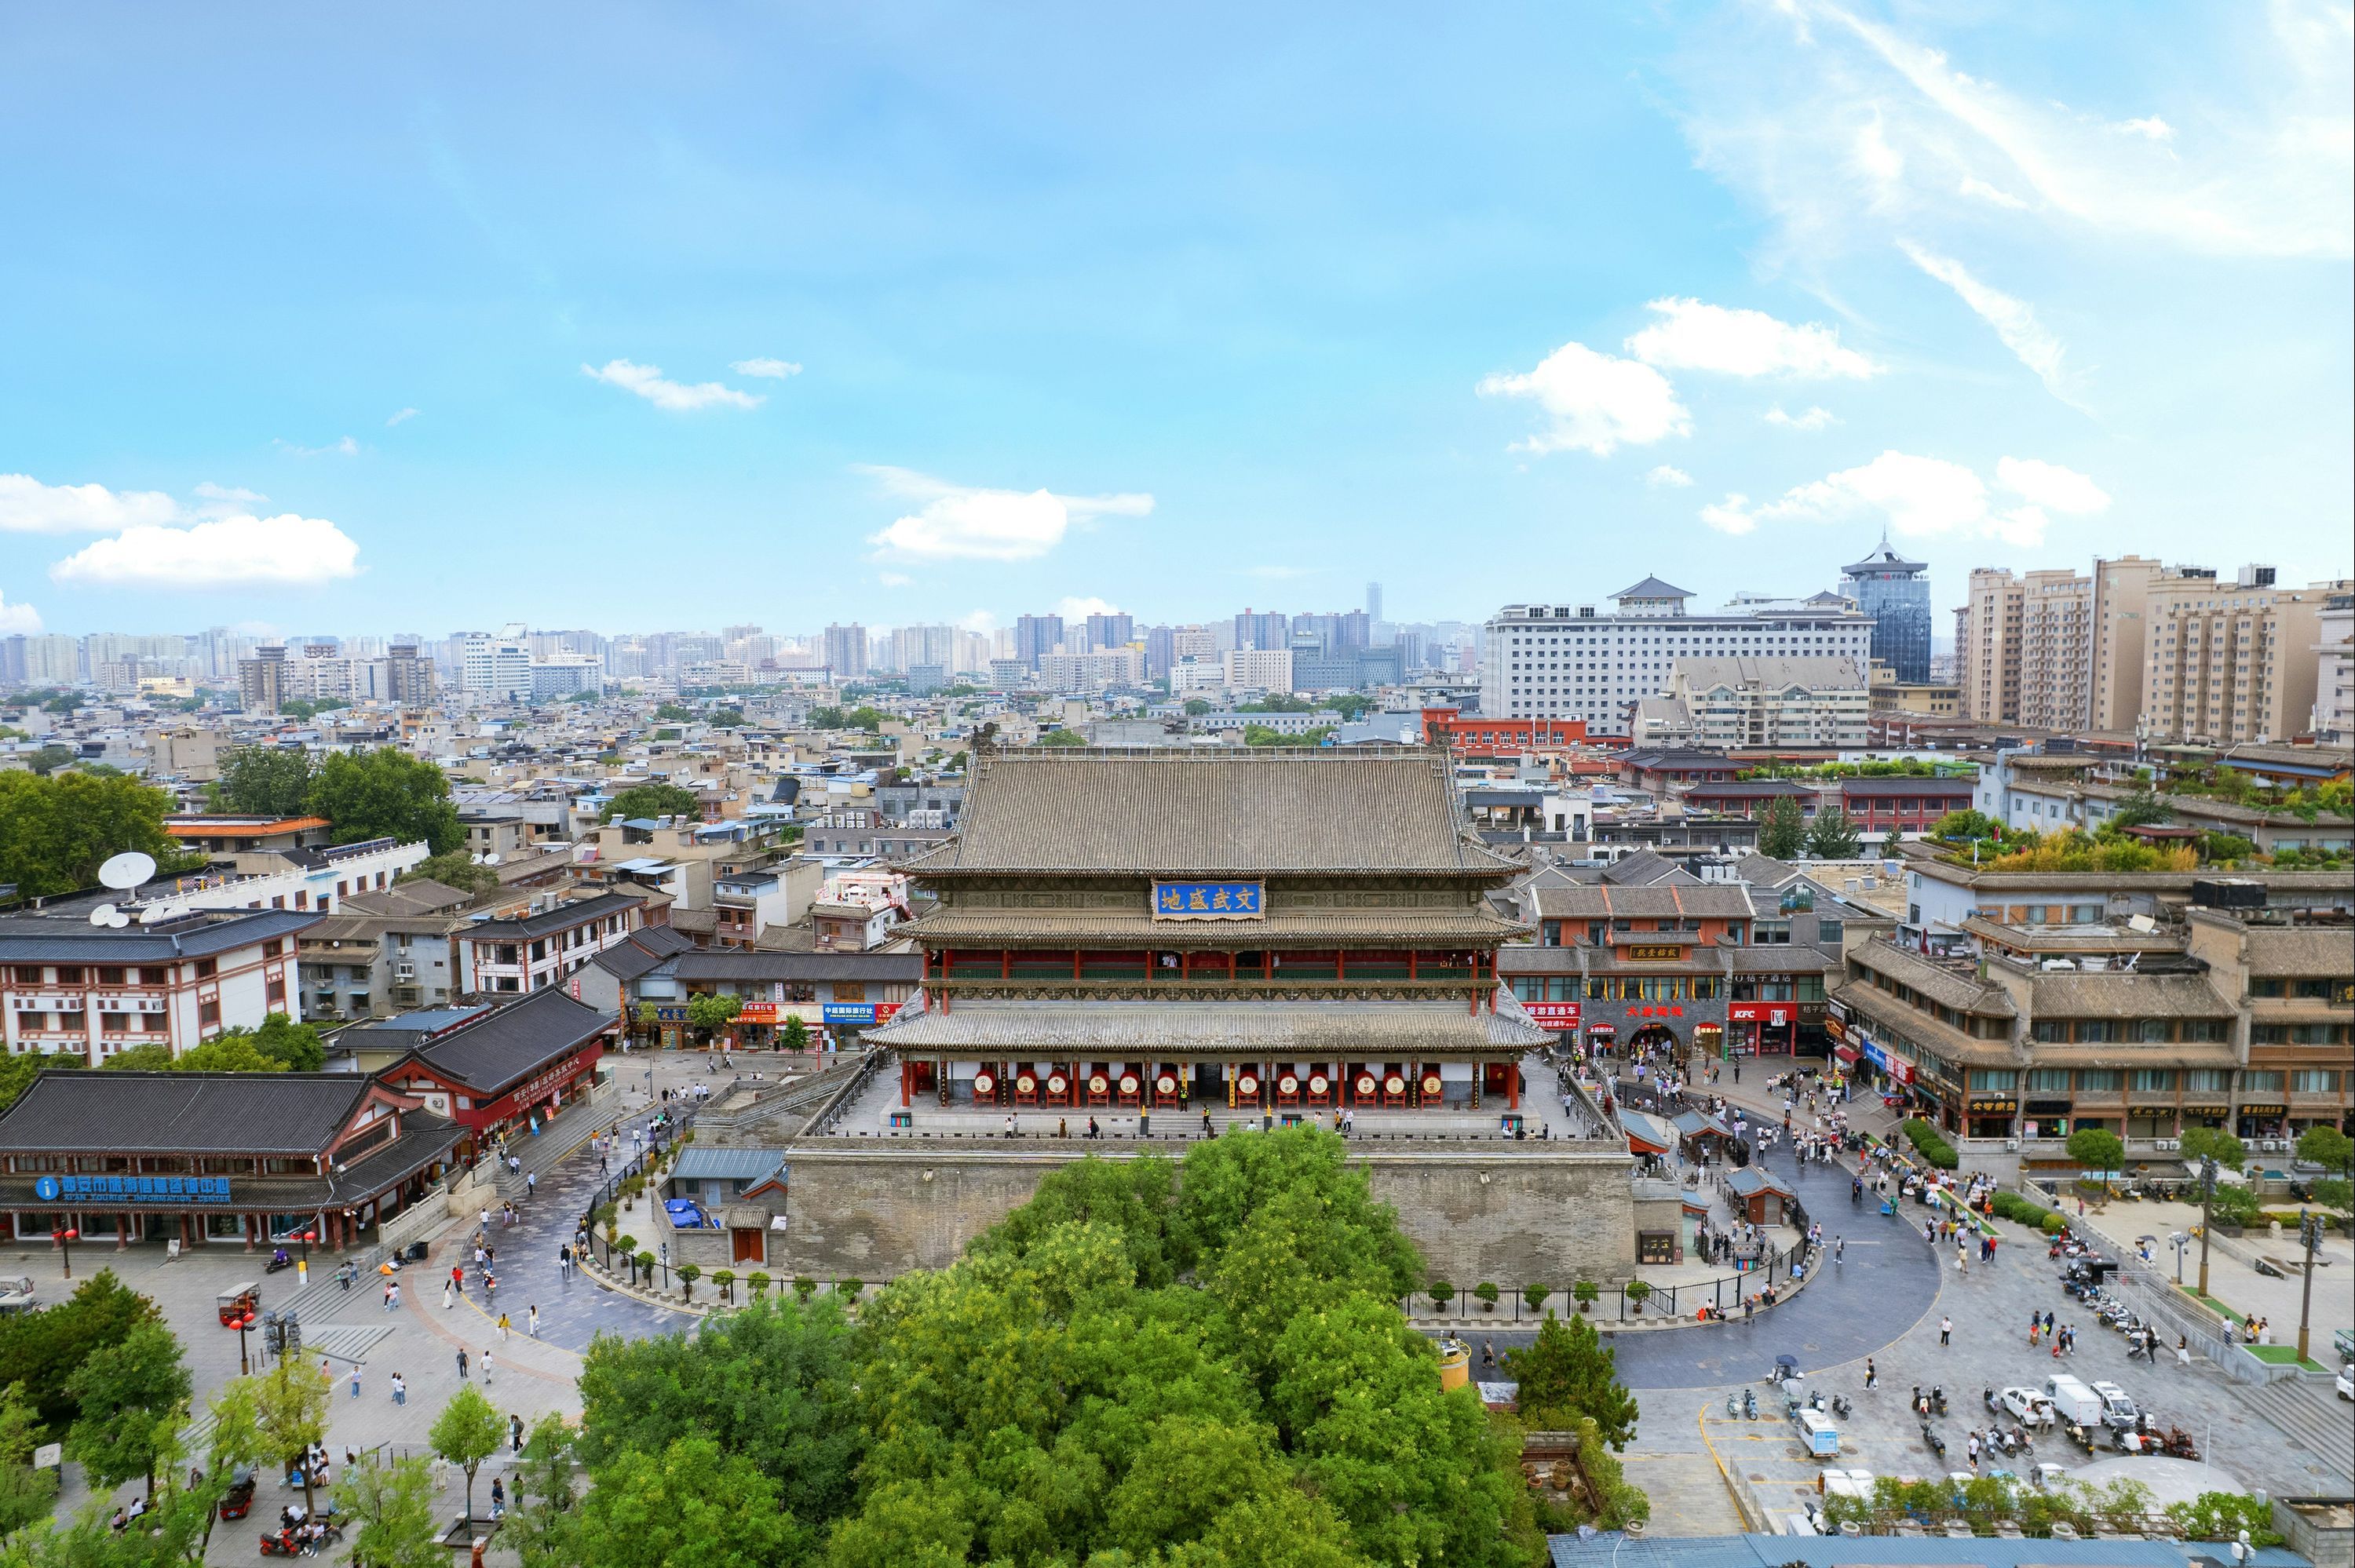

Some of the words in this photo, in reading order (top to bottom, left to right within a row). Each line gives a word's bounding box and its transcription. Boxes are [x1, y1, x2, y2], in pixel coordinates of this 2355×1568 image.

[1747, 974, 1791, 983] 桔子酒店
[1523, 1006, 1575, 1016] 旅游直通车
[1734, 1010, 1755, 1019] KFC
[62, 1176, 230, 1194] 西安市旅游信息咨询中心
